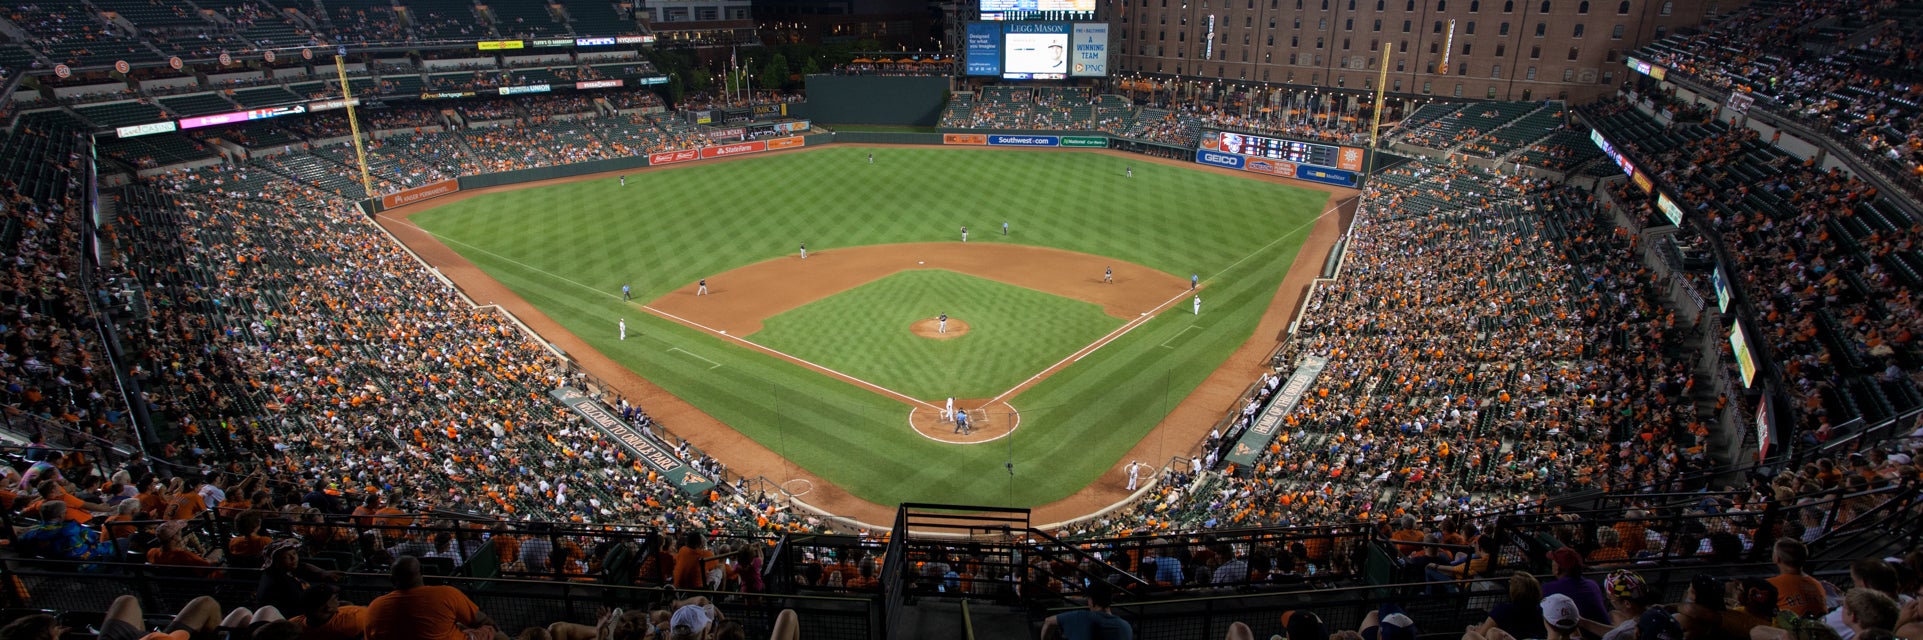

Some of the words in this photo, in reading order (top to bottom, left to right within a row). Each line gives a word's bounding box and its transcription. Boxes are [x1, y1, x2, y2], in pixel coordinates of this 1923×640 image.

[1010, 24, 1032, 32] LEGG
[1034, 24, 1063, 32] MASON
[142, 122, 174, 133] CASINO
[1204, 153, 1238, 165] GEICO
[1274, 394, 1294, 407] THE
[1269, 406, 1284, 416] OF
[1254, 414, 1278, 434] HOME
[577, 402, 616, 428] WELCOME
[610, 424, 627, 435] TO
[621, 433, 656, 456] ORIOLE
[648, 452, 678, 470] PARK
